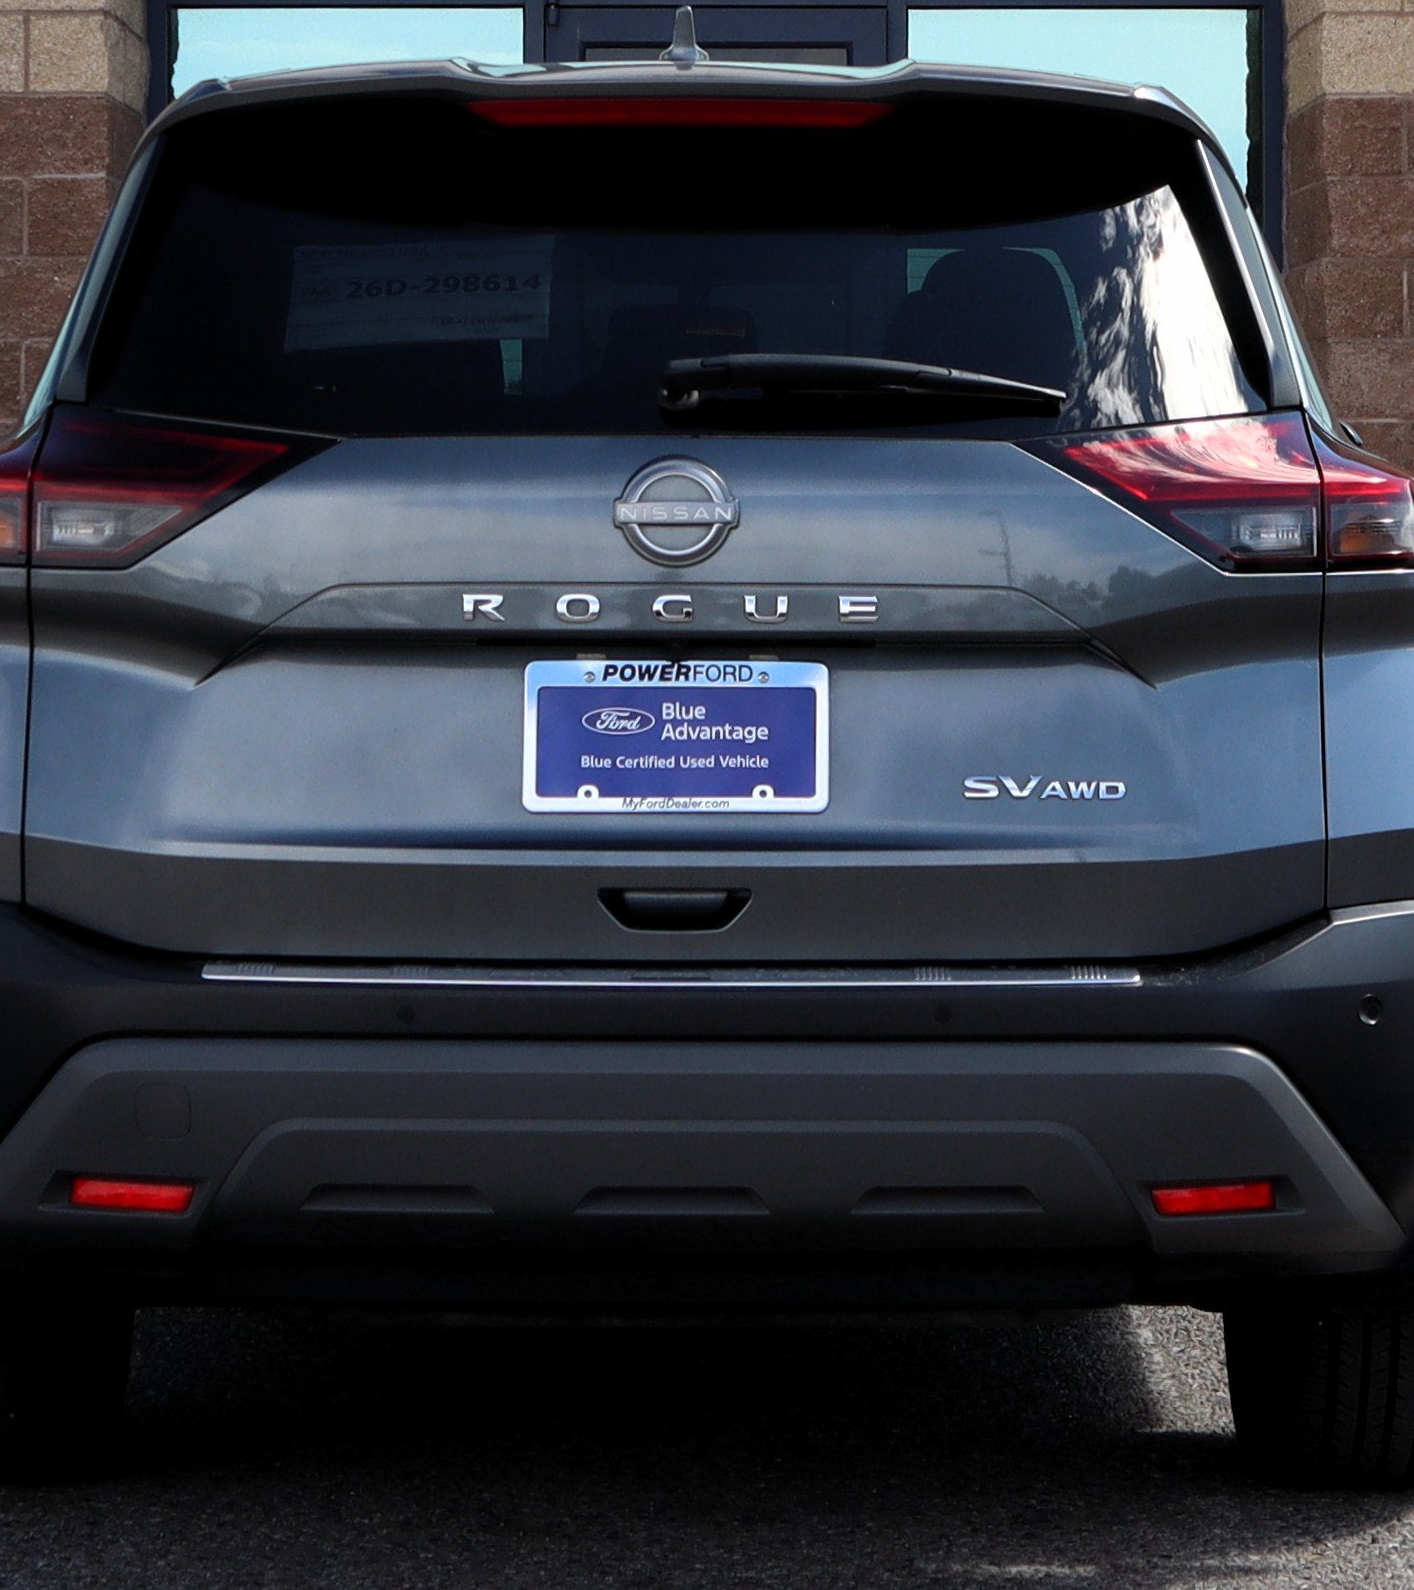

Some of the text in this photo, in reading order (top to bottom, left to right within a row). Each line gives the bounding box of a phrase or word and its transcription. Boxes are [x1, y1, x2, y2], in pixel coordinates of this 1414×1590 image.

[619, 505, 733, 521] NISSAN
[462, 593, 880, 623] ROGUE
[602, 663, 754, 682] POWERFORD
[595, 710, 642, 732] Ford
[661, 702, 706, 721] Blue
[660, 723, 769, 743] Advantage
[581, 755, 769, 768] Blue Certified Used Vehicle
[621, 798, 730, 810] MyFordDealer.com
